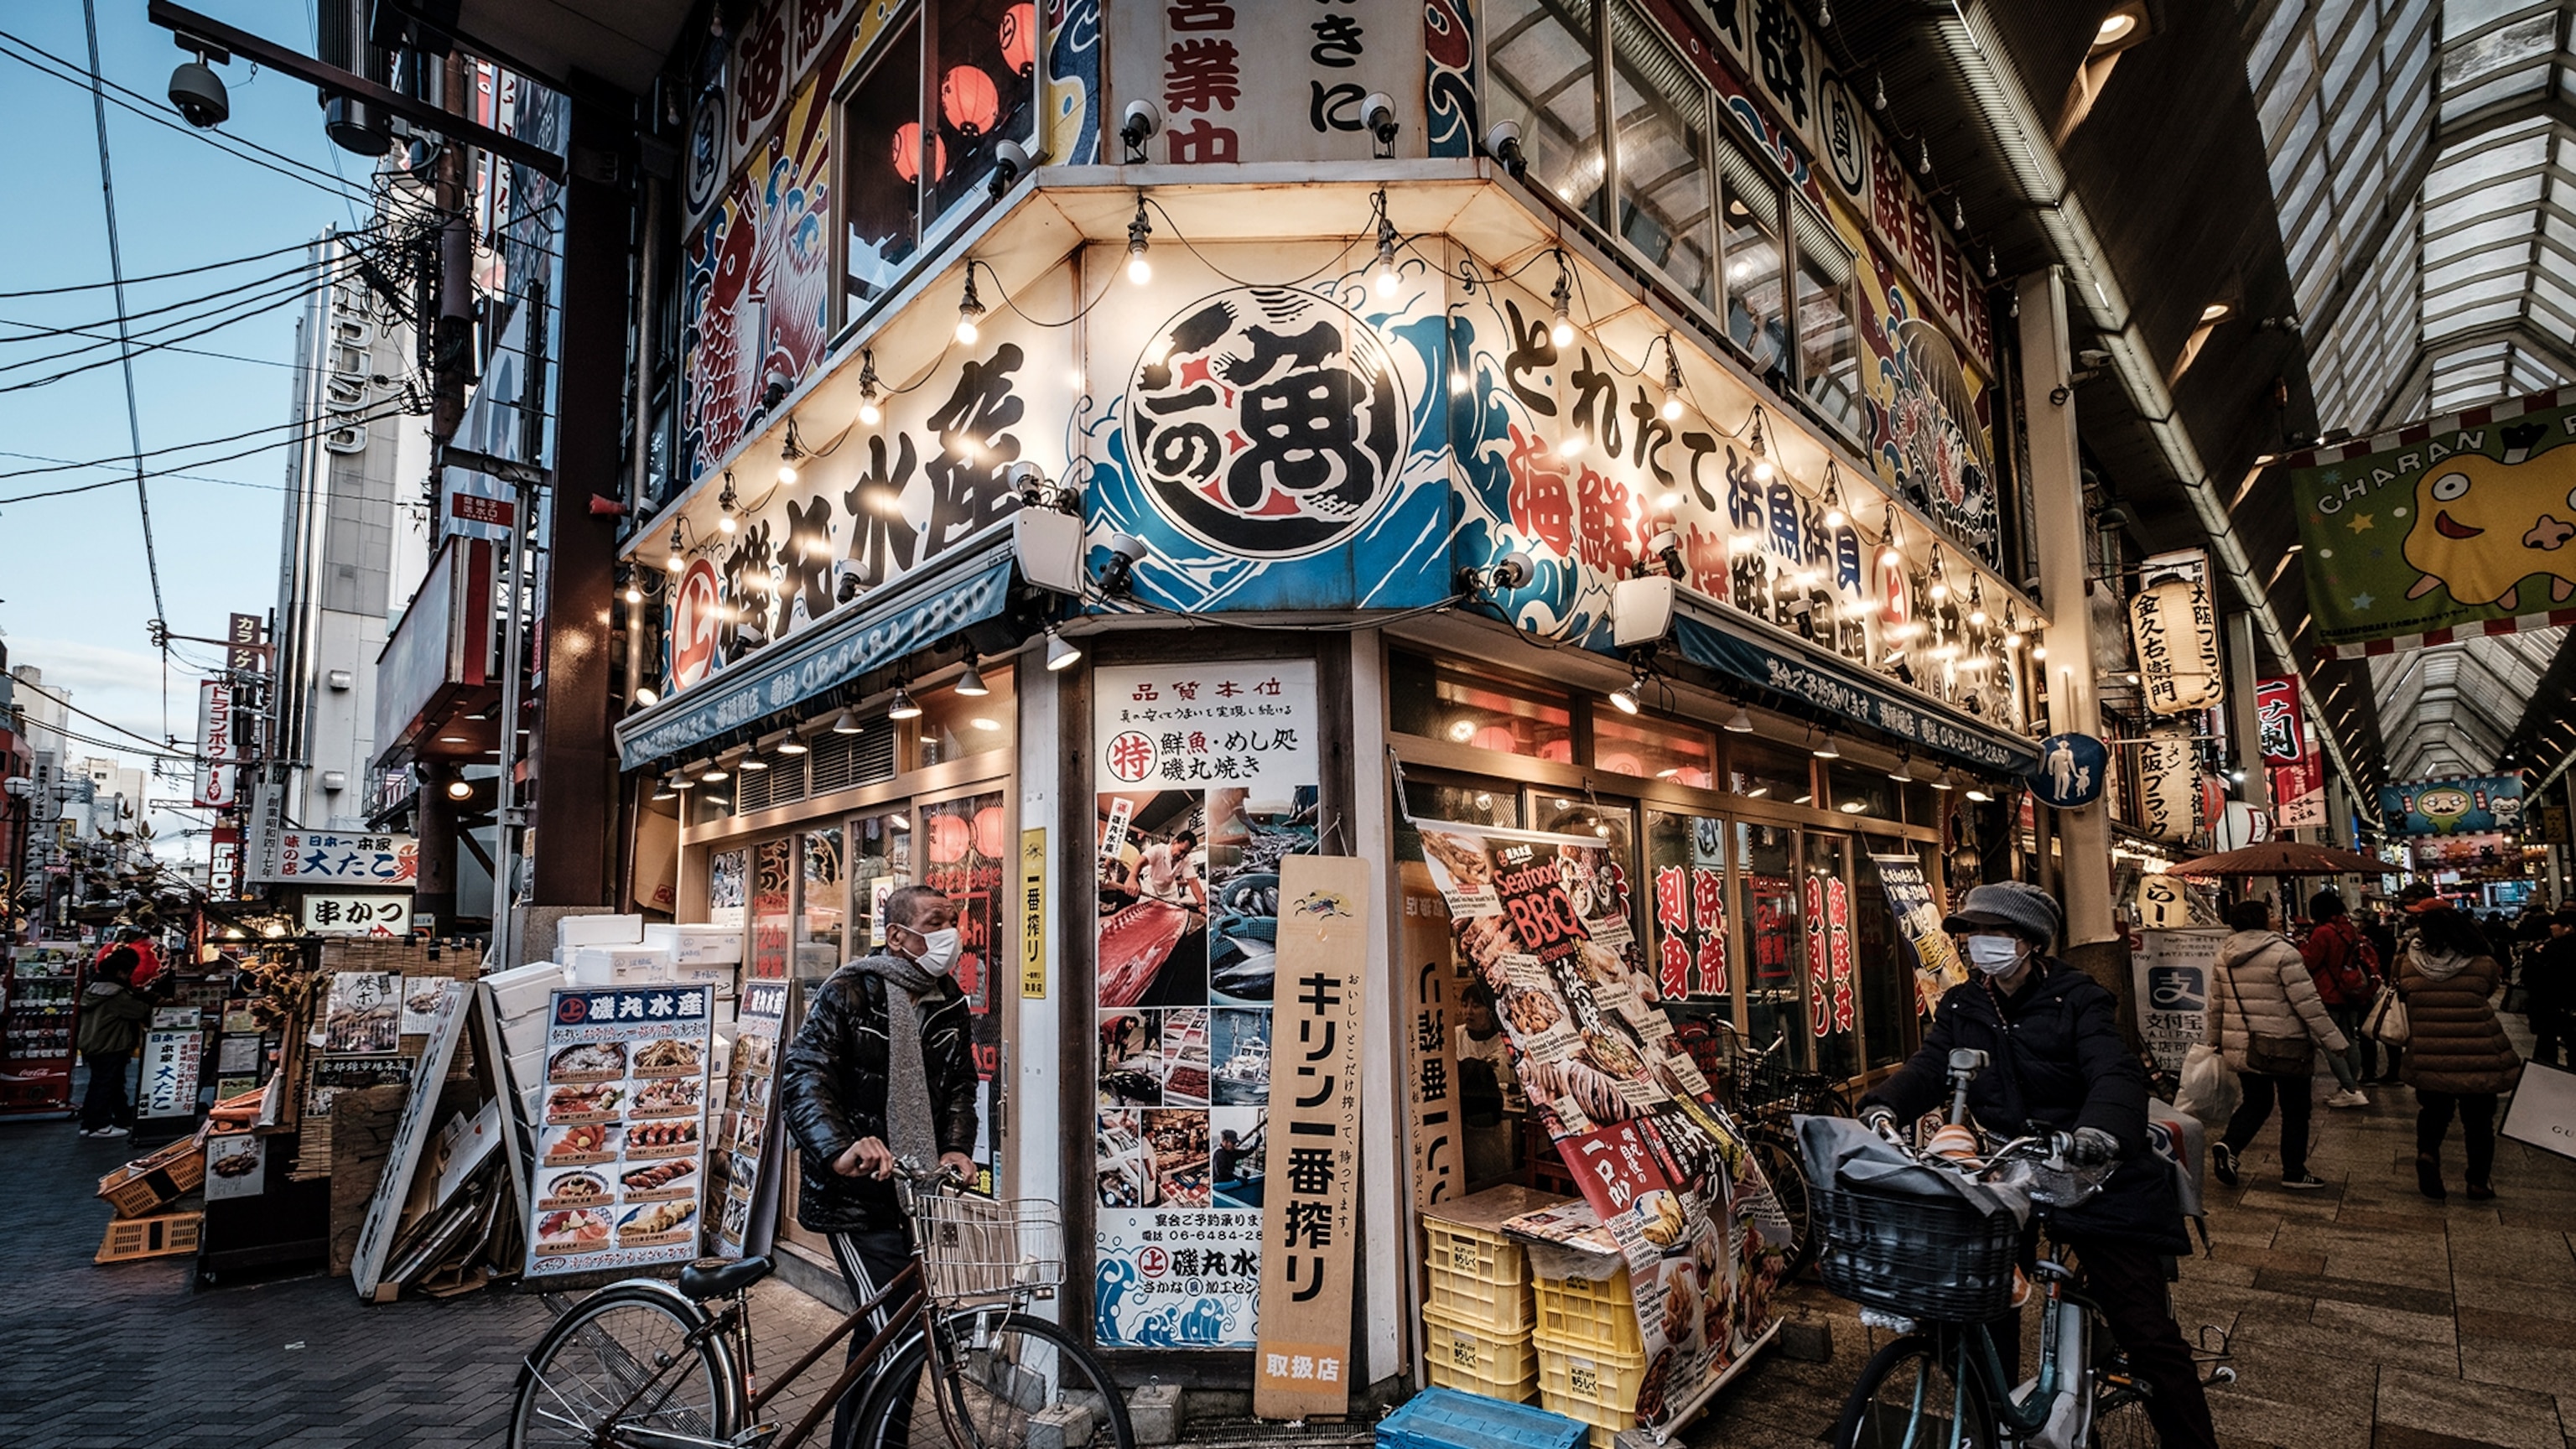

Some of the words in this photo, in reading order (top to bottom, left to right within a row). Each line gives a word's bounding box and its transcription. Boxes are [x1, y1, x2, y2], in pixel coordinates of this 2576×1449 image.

[1311, 0, 1368, 132] きに
[1504, 299, 1716, 512] とれたて
[721, 342, 1025, 650] 磯丸水産
[2317, 430, 2485, 515] CHARAN
[235, 616, 254, 668] カラケ
[2134, 595, 2177, 706] 金久右衛門
[1132, 677, 1282, 702] 品質本位
[1110, 734, 1154, 780] 特
[1160, 728, 1297, 756] 鮮魚・めし処
[1160, 756, 1260, 782] 磯丸焼き
[262, 797, 278, 877] 創業昭和四十七年
[282, 834, 301, 876] 味の店
[300, 849, 396, 877] 大たこ
[1493, 856, 1561, 897] Seafood
[315, 900, 403, 926] 串かつ
[957, 910, 984, 945] 4h
[1026, 875, 1040, 963] 一番搾り
[1508, 887, 1588, 949] BBQ
[2146, 882, 2175, 928] らー
[1656, 865, 1691, 1001] 刺身
[1693, 867, 1727, 996] 浜焼
[589, 992, 703, 1020] 磯丸水産
[2146, 1013, 2204, 1030] 支付宝
[1285, 973, 1342, 1302] キリン一番搾り
[1156, 1213, 1263, 1227] 宴会ご予約承りま
[1171, 1248, 1263, 1278] 磯丸水
[1266, 1353, 1341, 1382] 取扱店
